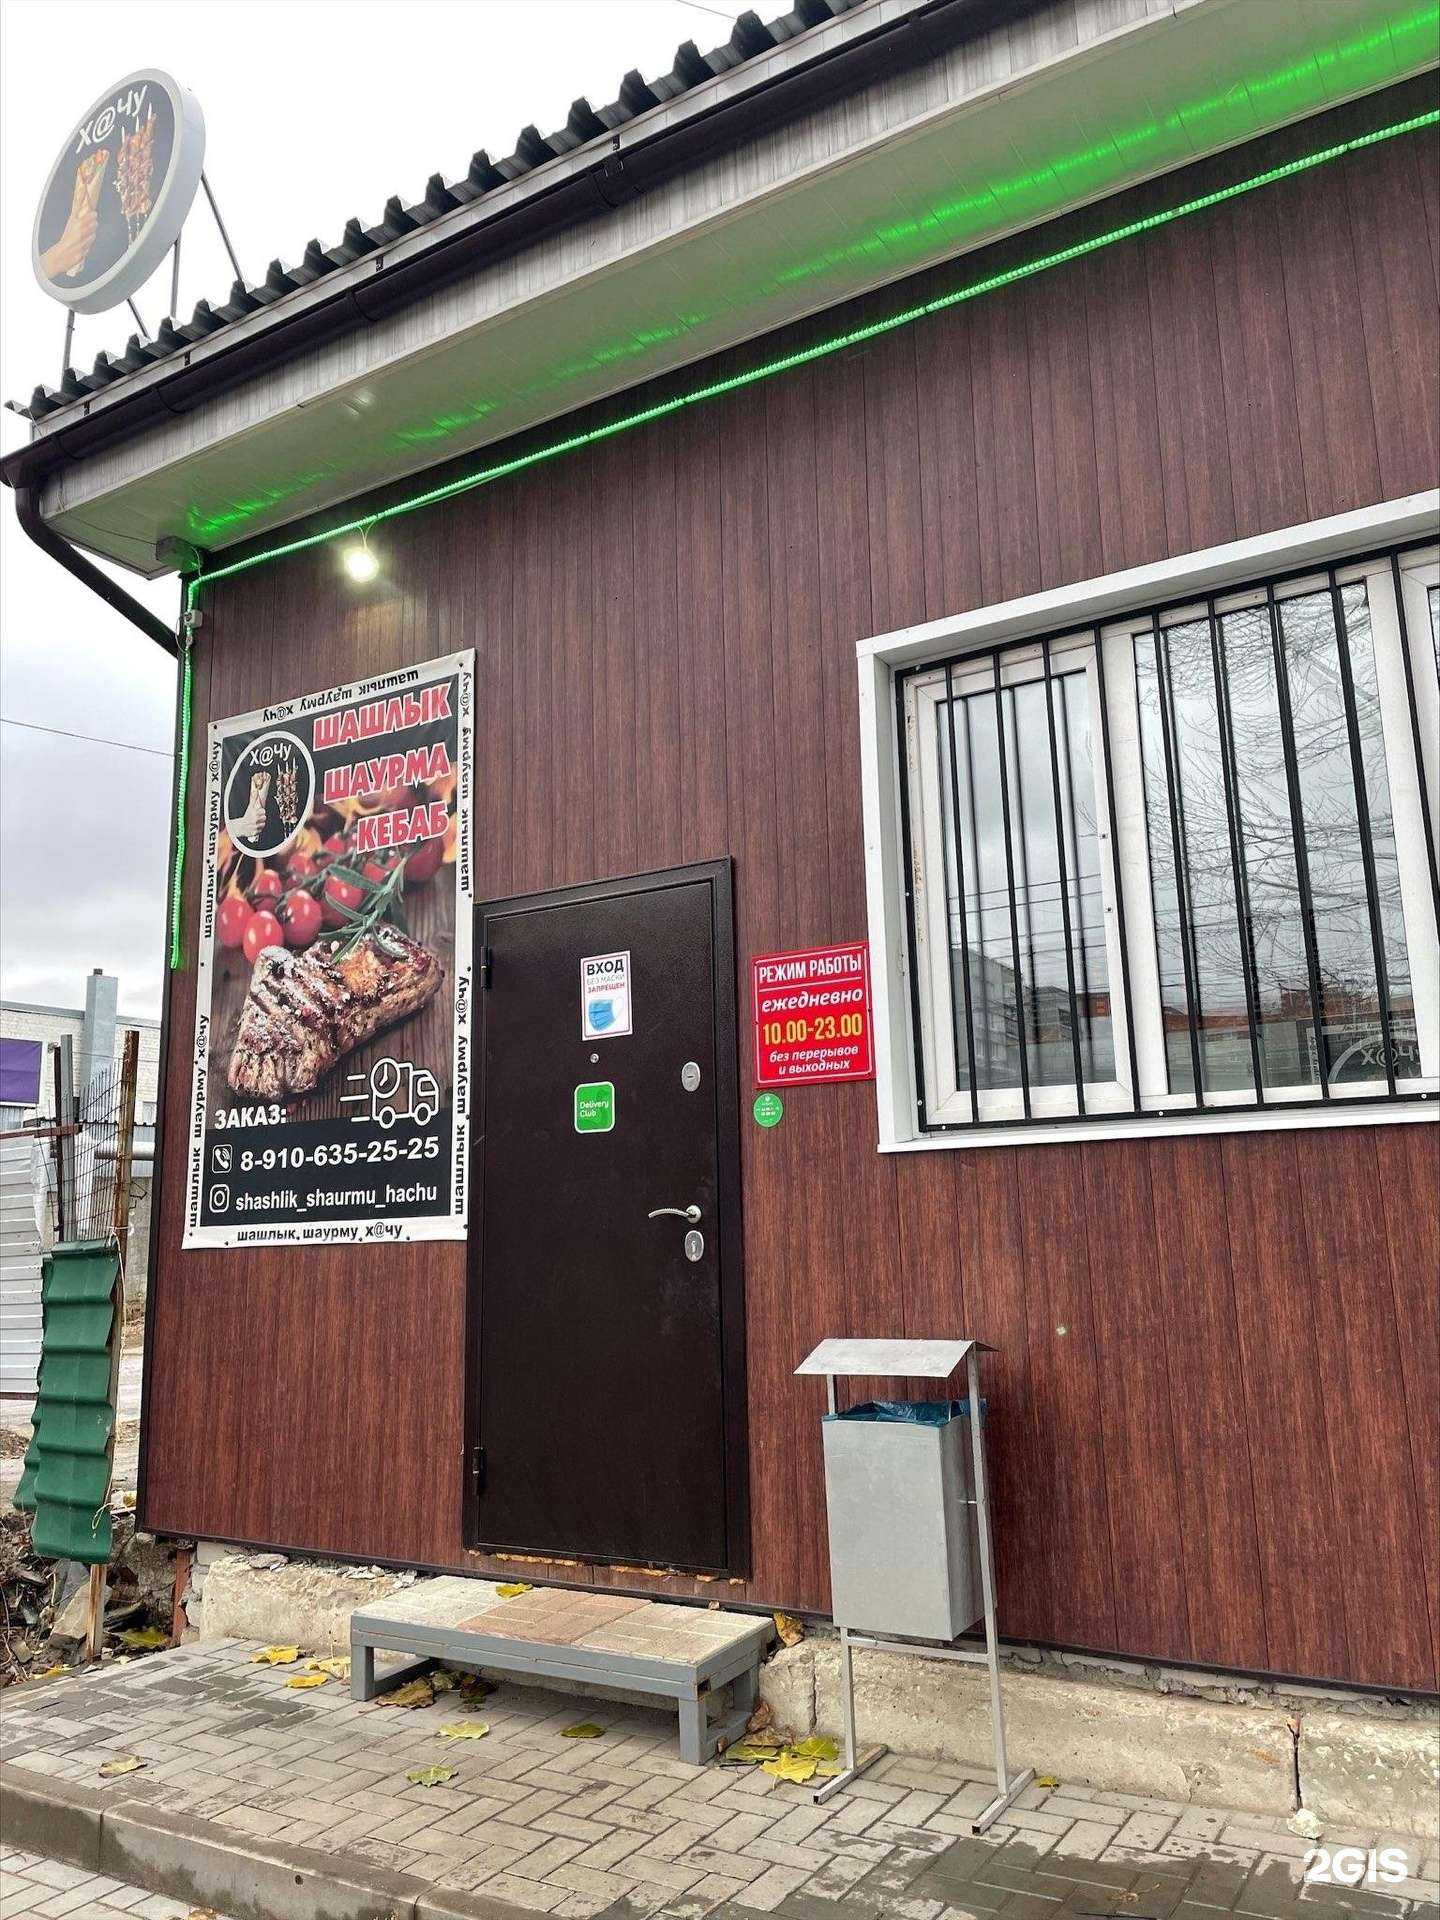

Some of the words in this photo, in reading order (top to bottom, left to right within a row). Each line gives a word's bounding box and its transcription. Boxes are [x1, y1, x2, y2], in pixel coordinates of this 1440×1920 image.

[299, 687, 353, 711] шаурму
[359, 669, 419, 695] шашлык
[262, 704, 294, 723] х@чу
[313, 682, 452, 751] ШАШЛЫК
[209, 741, 222, 783] х@чу
[323, 742, 450, 804] ШАУРМА
[208, 791, 221, 855] шаурму
[357, 801, 449, 854] КЕБАБ
[460, 808, 469, 891] шашлык
[204, 862, 215, 938] шашлык
[587, 959, 624, 975] ВХОД
[759, 961, 806, 983] РЕЖИМ
[809, 954, 862, 977] РАБОТЫ
[456, 976, 470, 1025] х@чу
[762, 988, 863, 1012] ежедневно
[196, 1015, 209, 1058] х@чу
[763, 1013, 862, 1045] 10.00-23.00
[770, 1051, 789, 1063] без
[792, 1045, 858, 1060] перерывов
[779, 1066, 786, 1075] и
[789, 1060, 850, 1074] выходных
[457, 1035, 468, 1114] шаурму
[194, 1068, 207, 1138] шаурму
[214, 1104, 287, 1130] ЗАКАЗ:
[580, 1101, 608, 1109] Delivery
[580, 1109, 597, 1117] Club
[240, 1136, 440, 1172] 8-910-635-25-25
[455, 1124, 465, 1215] шашлык
[190, 1147, 200, 1227] шашлык
[235, 1183, 437, 1212] shashlik_shaurmu_hachu
[237, 1229, 296, 1242] шашлык
[303, 1225, 358, 1243] шаурму
[365, 1222, 403, 1239] х@чу
